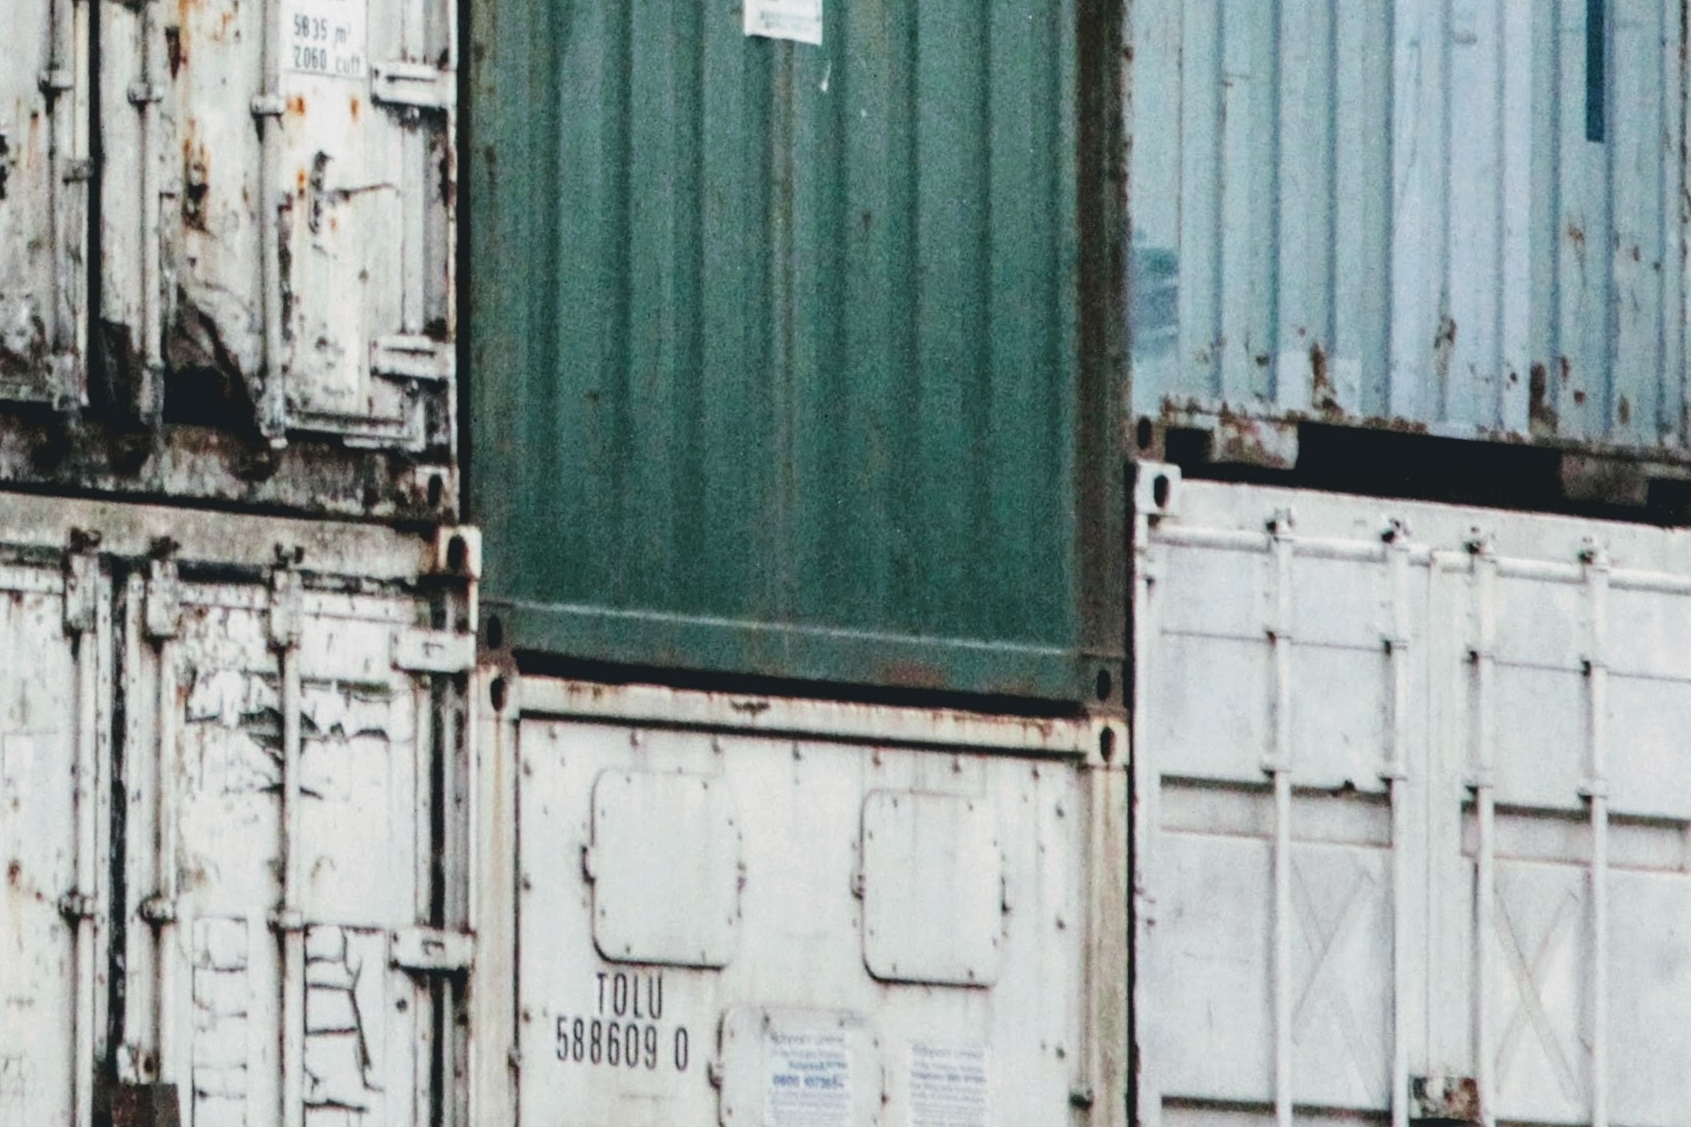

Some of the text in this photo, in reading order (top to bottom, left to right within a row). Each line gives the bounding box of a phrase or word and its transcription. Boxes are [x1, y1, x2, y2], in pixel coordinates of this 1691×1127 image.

[294, 45, 328, 72] 2060
[597, 972, 662, 1019] TOLU
[556, 1014, 688, 1072] 588609 0
